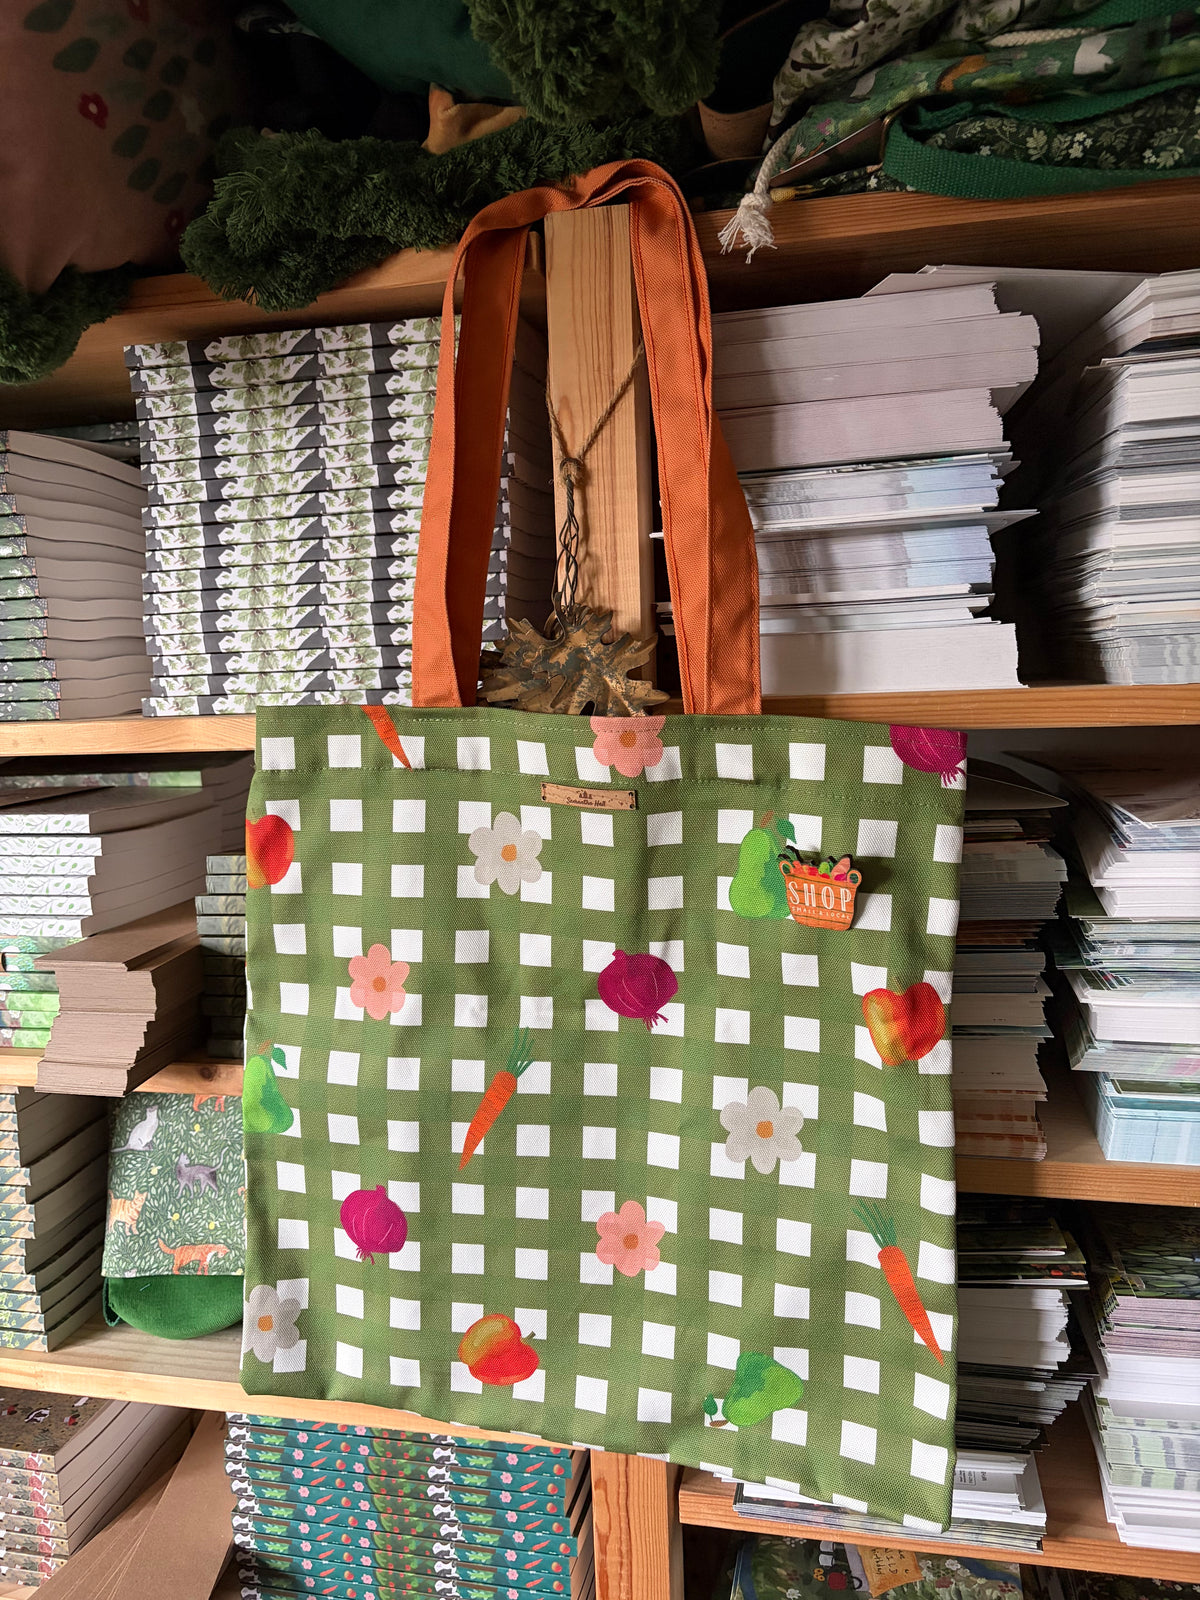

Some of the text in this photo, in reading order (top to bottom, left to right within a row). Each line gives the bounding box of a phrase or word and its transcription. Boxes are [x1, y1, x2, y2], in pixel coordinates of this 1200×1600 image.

[788, 881, 852, 912] SHOP
[792, 906, 816, 915] SMALL
[826, 911, 851, 920] LOCAL
